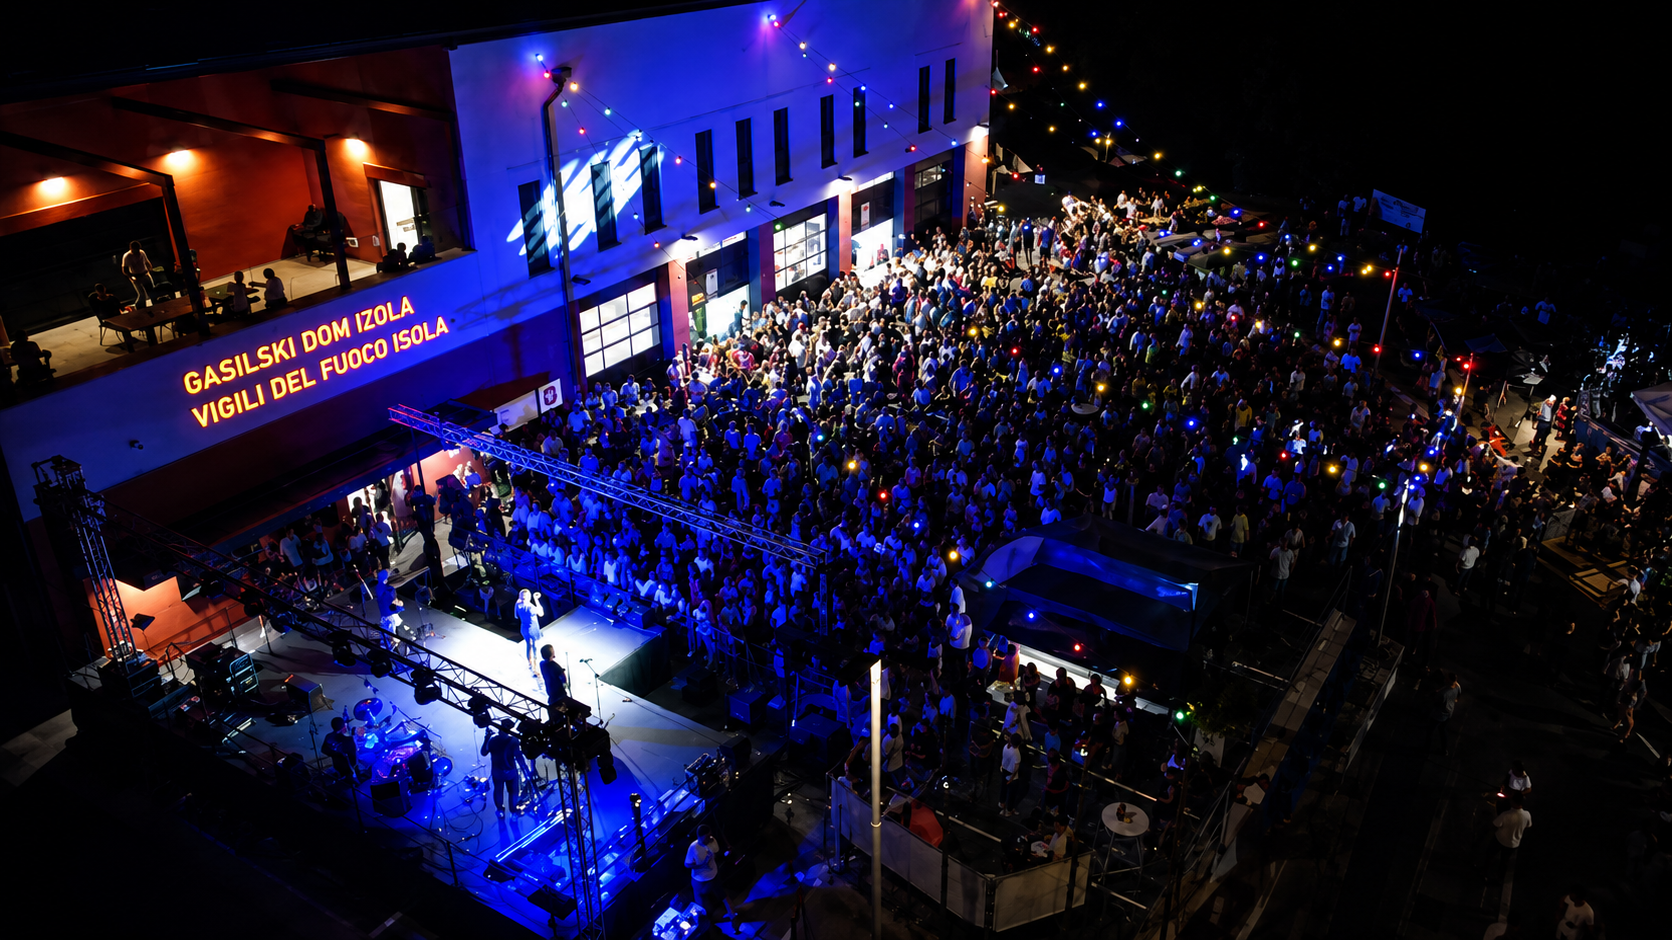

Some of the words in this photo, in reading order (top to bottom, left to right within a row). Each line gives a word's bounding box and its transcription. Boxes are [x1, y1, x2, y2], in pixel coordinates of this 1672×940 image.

[183, 336, 297, 395] GASILSKI
[301, 316, 351, 353] DOM
[354, 296, 415, 334] IZOLA
[190, 383, 266, 428] VIGILI
[269, 367, 317, 400] DEL
[319, 338, 388, 381] FUOCO
[391, 316, 450, 353] ISOLA
